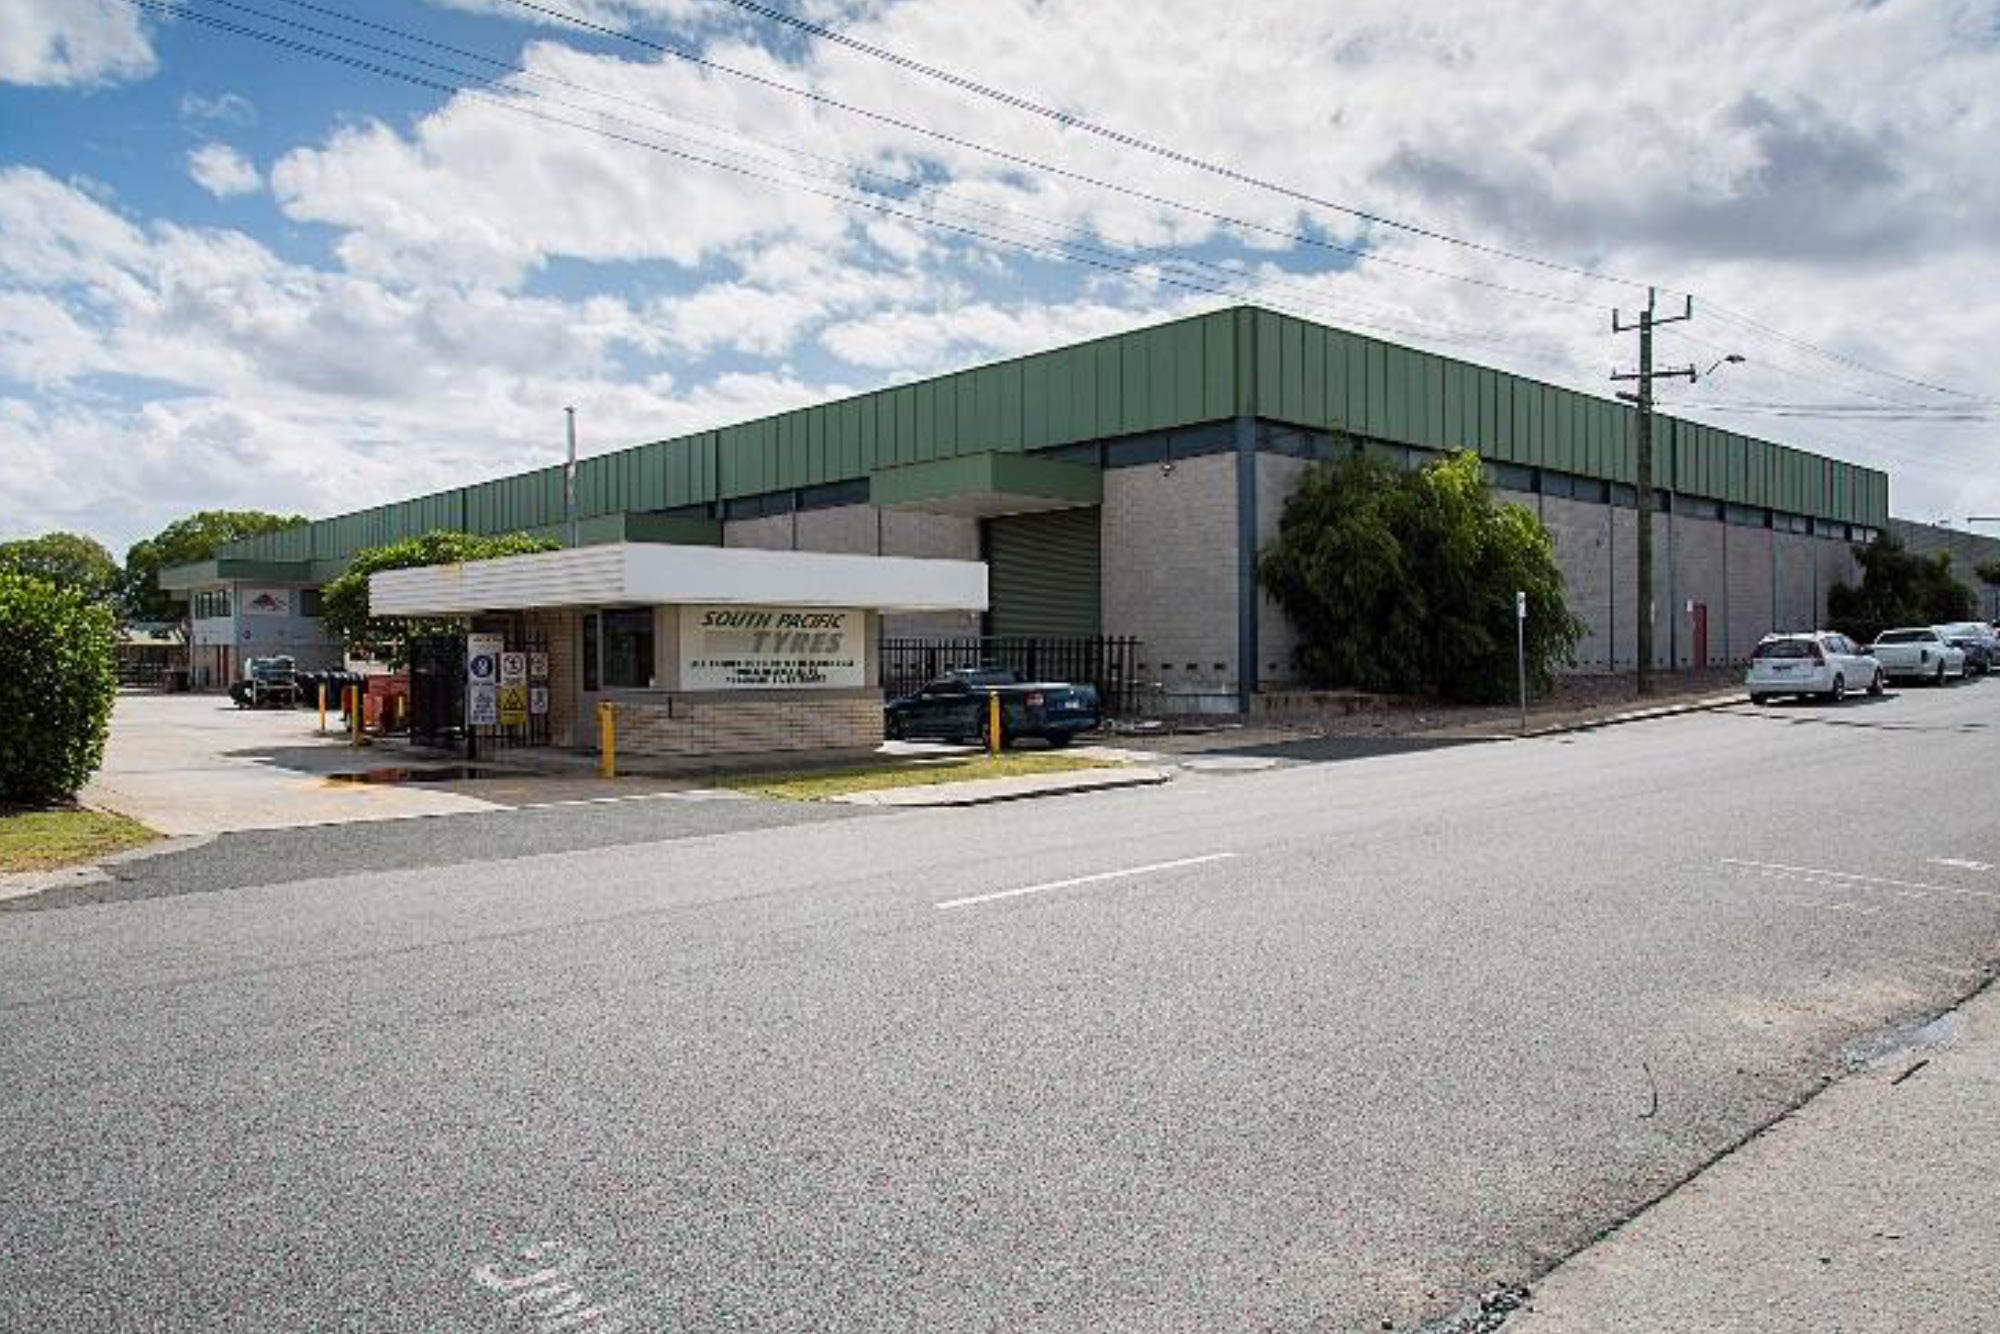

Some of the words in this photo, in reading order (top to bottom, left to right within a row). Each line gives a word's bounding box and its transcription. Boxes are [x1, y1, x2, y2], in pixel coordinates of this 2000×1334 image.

[701, 610, 772, 627] SOUTH
[776, 613, 846, 629] PACIFIC
[752, 630, 845, 654] TYRES
